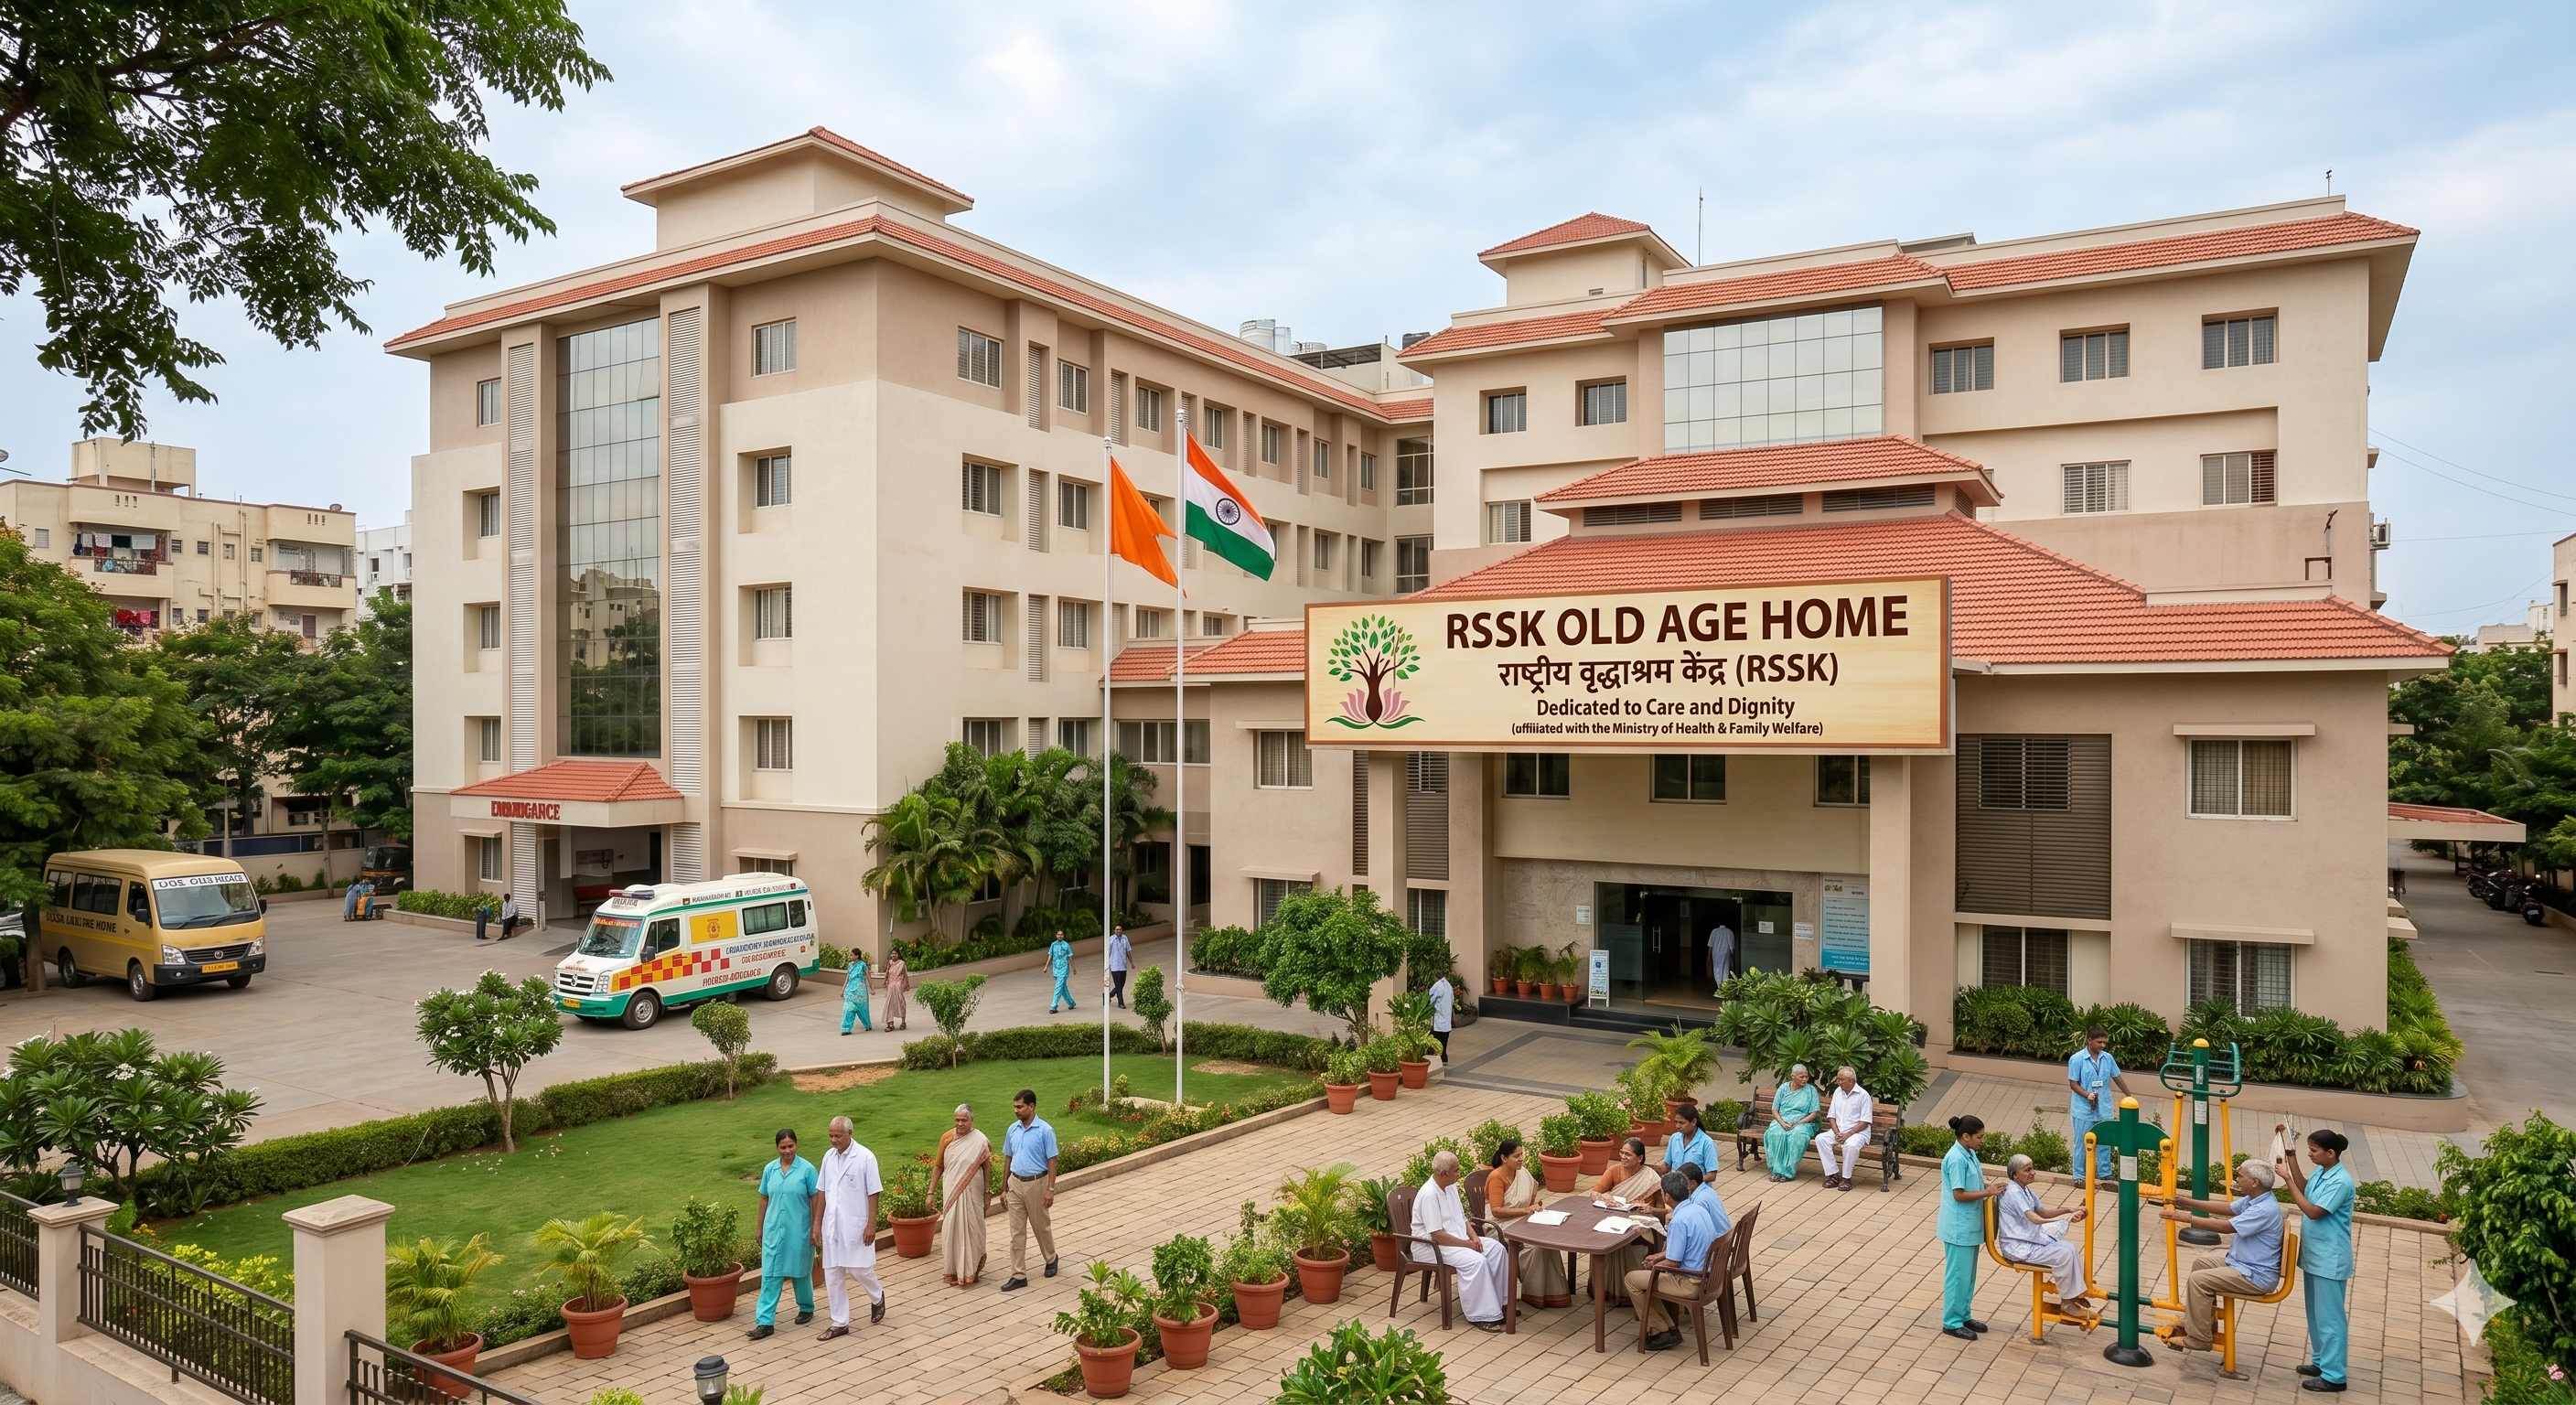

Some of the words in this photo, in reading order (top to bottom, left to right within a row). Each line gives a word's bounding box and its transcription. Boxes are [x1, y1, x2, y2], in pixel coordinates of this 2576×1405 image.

[1447, 609, 1547, 649] RSSK
[1557, 606, 1645, 646] OLD
[1657, 602, 1748, 642] AGE
[1762, 595, 1909, 640] HOME
[1497, 655, 1573, 694] राष्ट्रीय
[1578, 659, 1675, 693] वृद्धाश्रम
[1680, 650, 1728, 686] केंद्र
[1735, 652, 1839, 687] (RSSK)
[1537, 698, 1620, 716] Dedicated
[1624, 700, 1642, 716] to
[1646, 698, 1685, 715] Care
[1689, 697, 1723, 715] and
[1728, 697, 1796, 720] Dignity
[1565, 723, 1590, 734] with
[1592, 723, 1611, 734] the
[1613, 723, 1659, 737] Ministry
[1661, 723, 1674, 734] of
[1676, 723, 1715, 735] Health
[1717, 723, 1727, 735] &
[1729, 723, 1770, 737] Family
[1772, 722, 1823, 736] Welfare)
